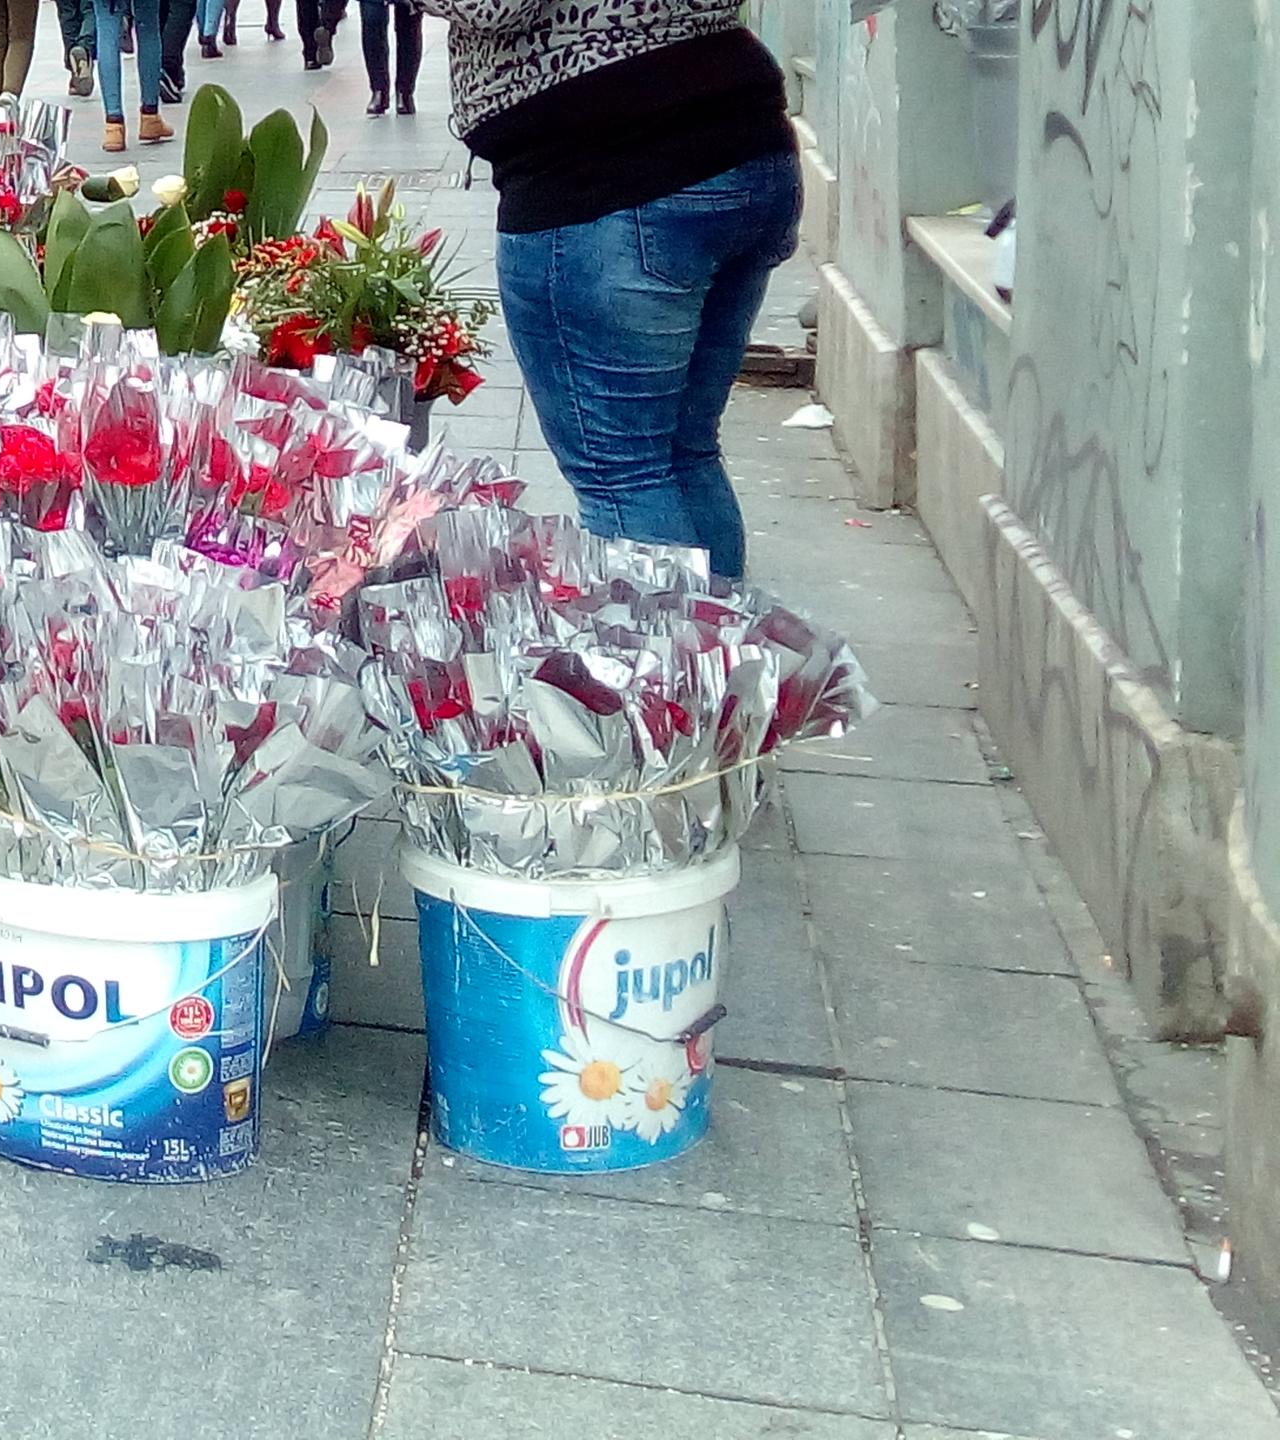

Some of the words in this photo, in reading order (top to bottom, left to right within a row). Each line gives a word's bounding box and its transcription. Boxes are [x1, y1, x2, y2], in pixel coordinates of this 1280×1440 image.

[609, 925, 716, 1020] jupol
[38, 1095, 125, 1129] Classic
[163, 1139, 189, 1154] 15L
[587, 1126, 609, 1147] JUB
